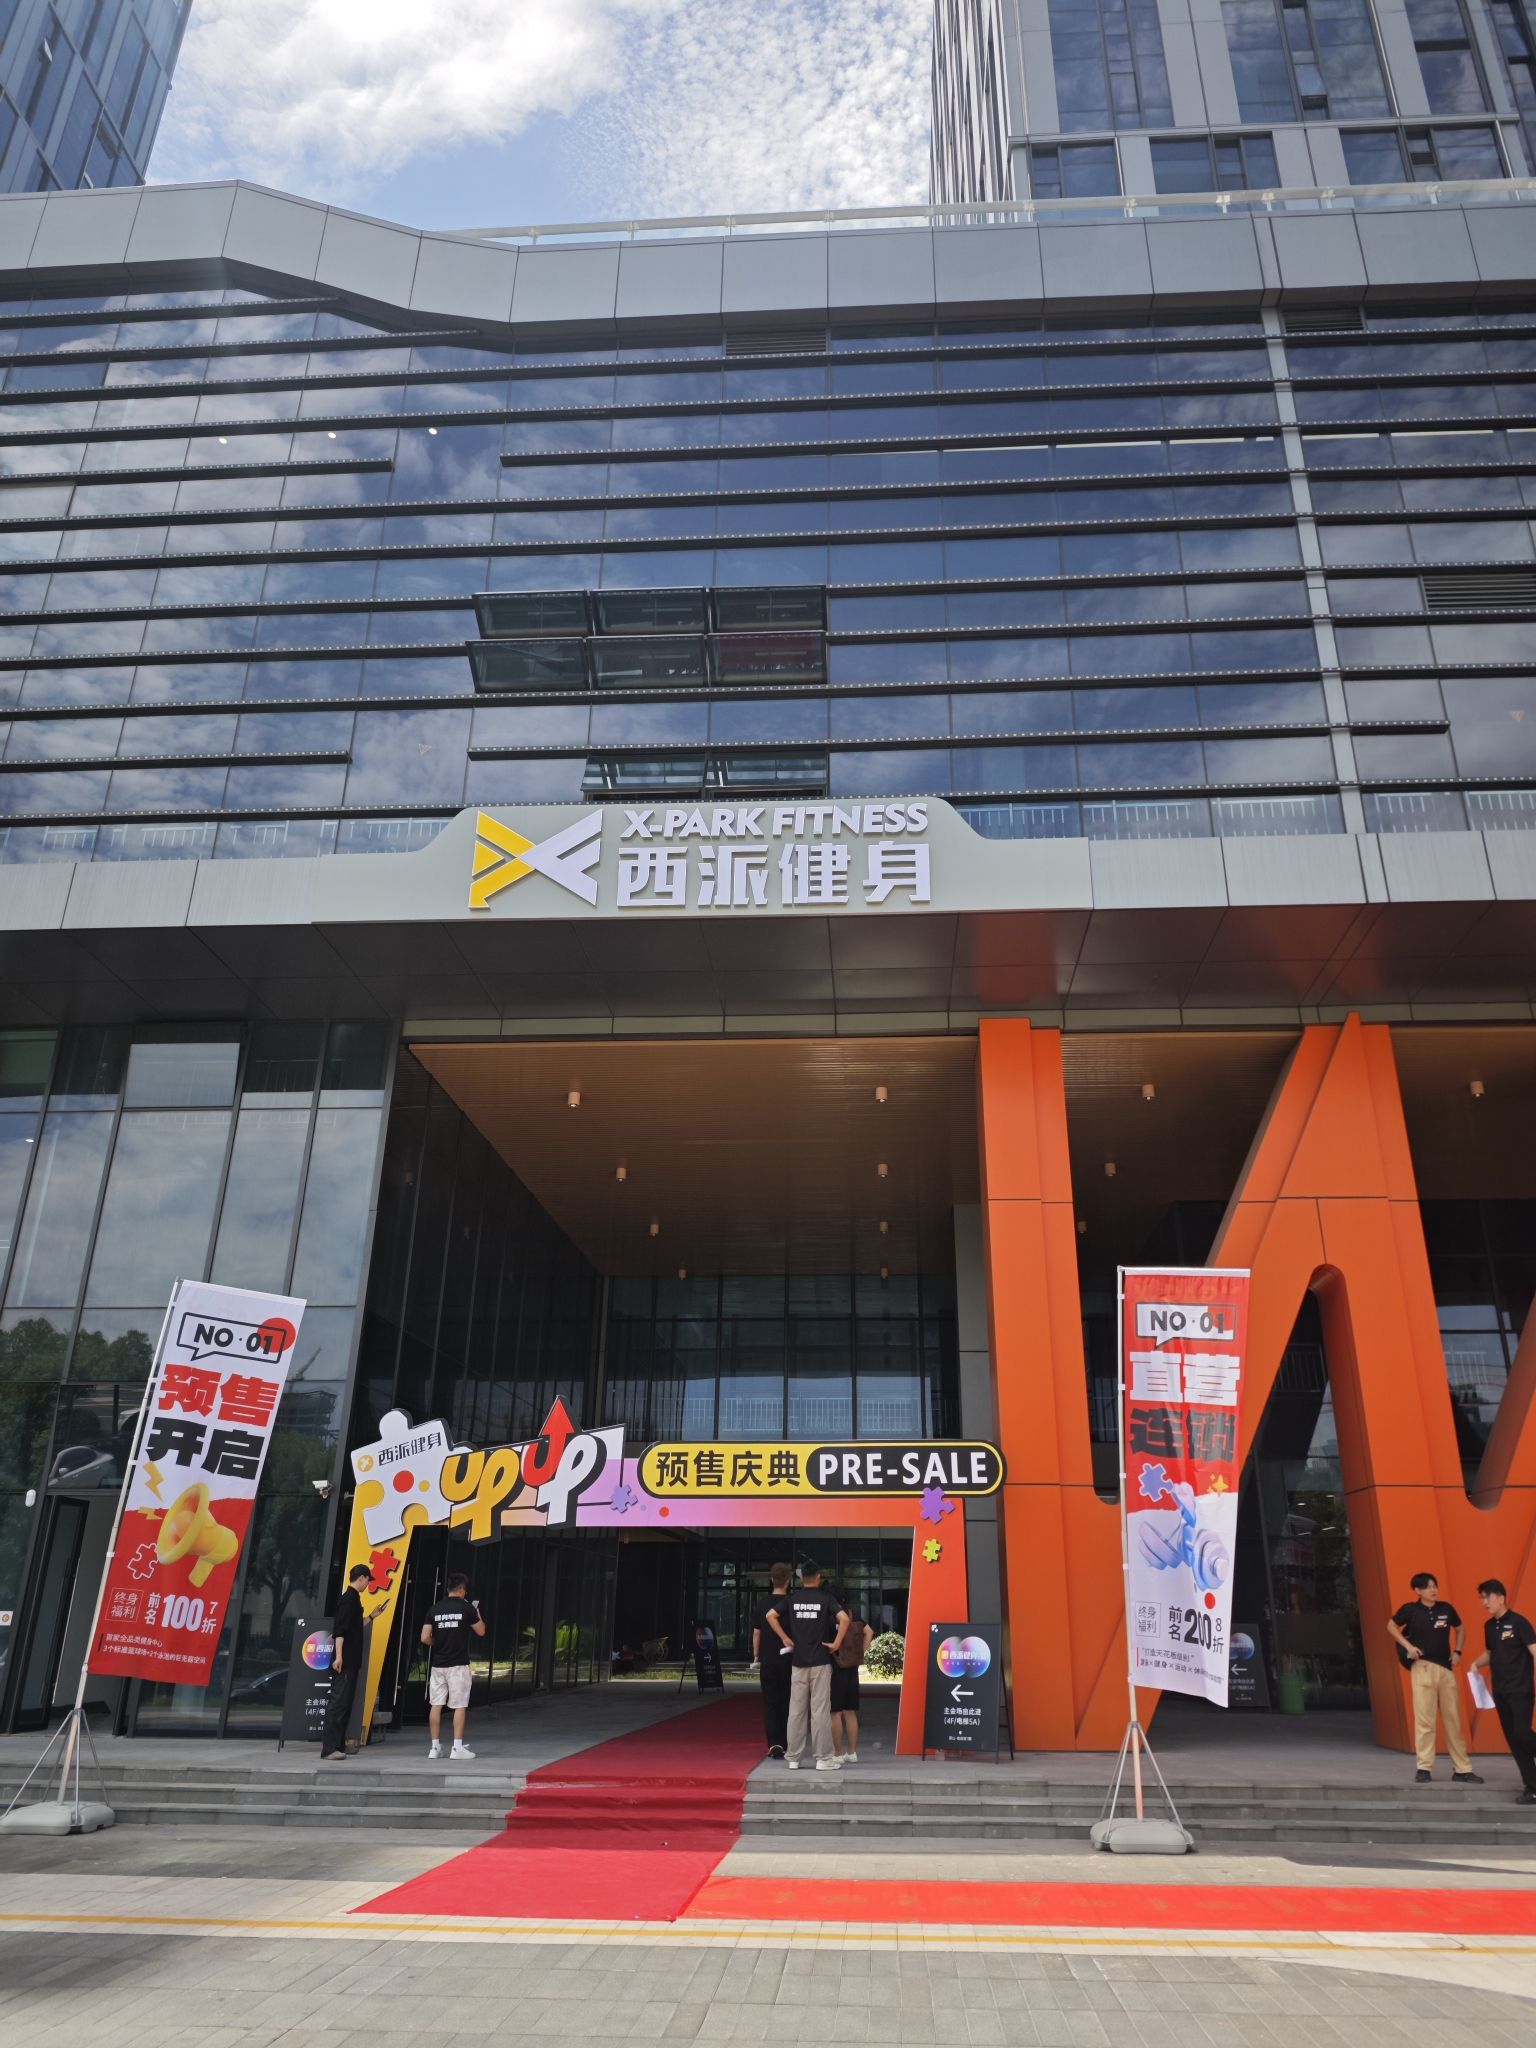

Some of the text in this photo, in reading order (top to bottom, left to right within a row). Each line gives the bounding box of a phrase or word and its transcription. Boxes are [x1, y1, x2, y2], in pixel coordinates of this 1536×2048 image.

[620, 802, 929, 838] X-PARK FITNESS
[616, 840, 932, 907] 西派健身
[158, 1363, 280, 1427] 预售
[1129, 1351, 1241, 1406] 直营
[145, 1416, 265, 1480] 开启
[378, 1431, 443, 1467] 西派健身
[1129, 1407, 1237, 1464] 连锁
[655, 1451, 802, 1488] 预售庆典
[819, 1452, 989, 1485] PRE-SALE
[110, 1605, 136, 1619] 福利
[113, 1591, 138, 1605] 终身
[161, 1594, 204, 1632] 100
[1138, 1605, 1157, 1619] 终身
[1138, 1619, 1157, 1633] 福利
